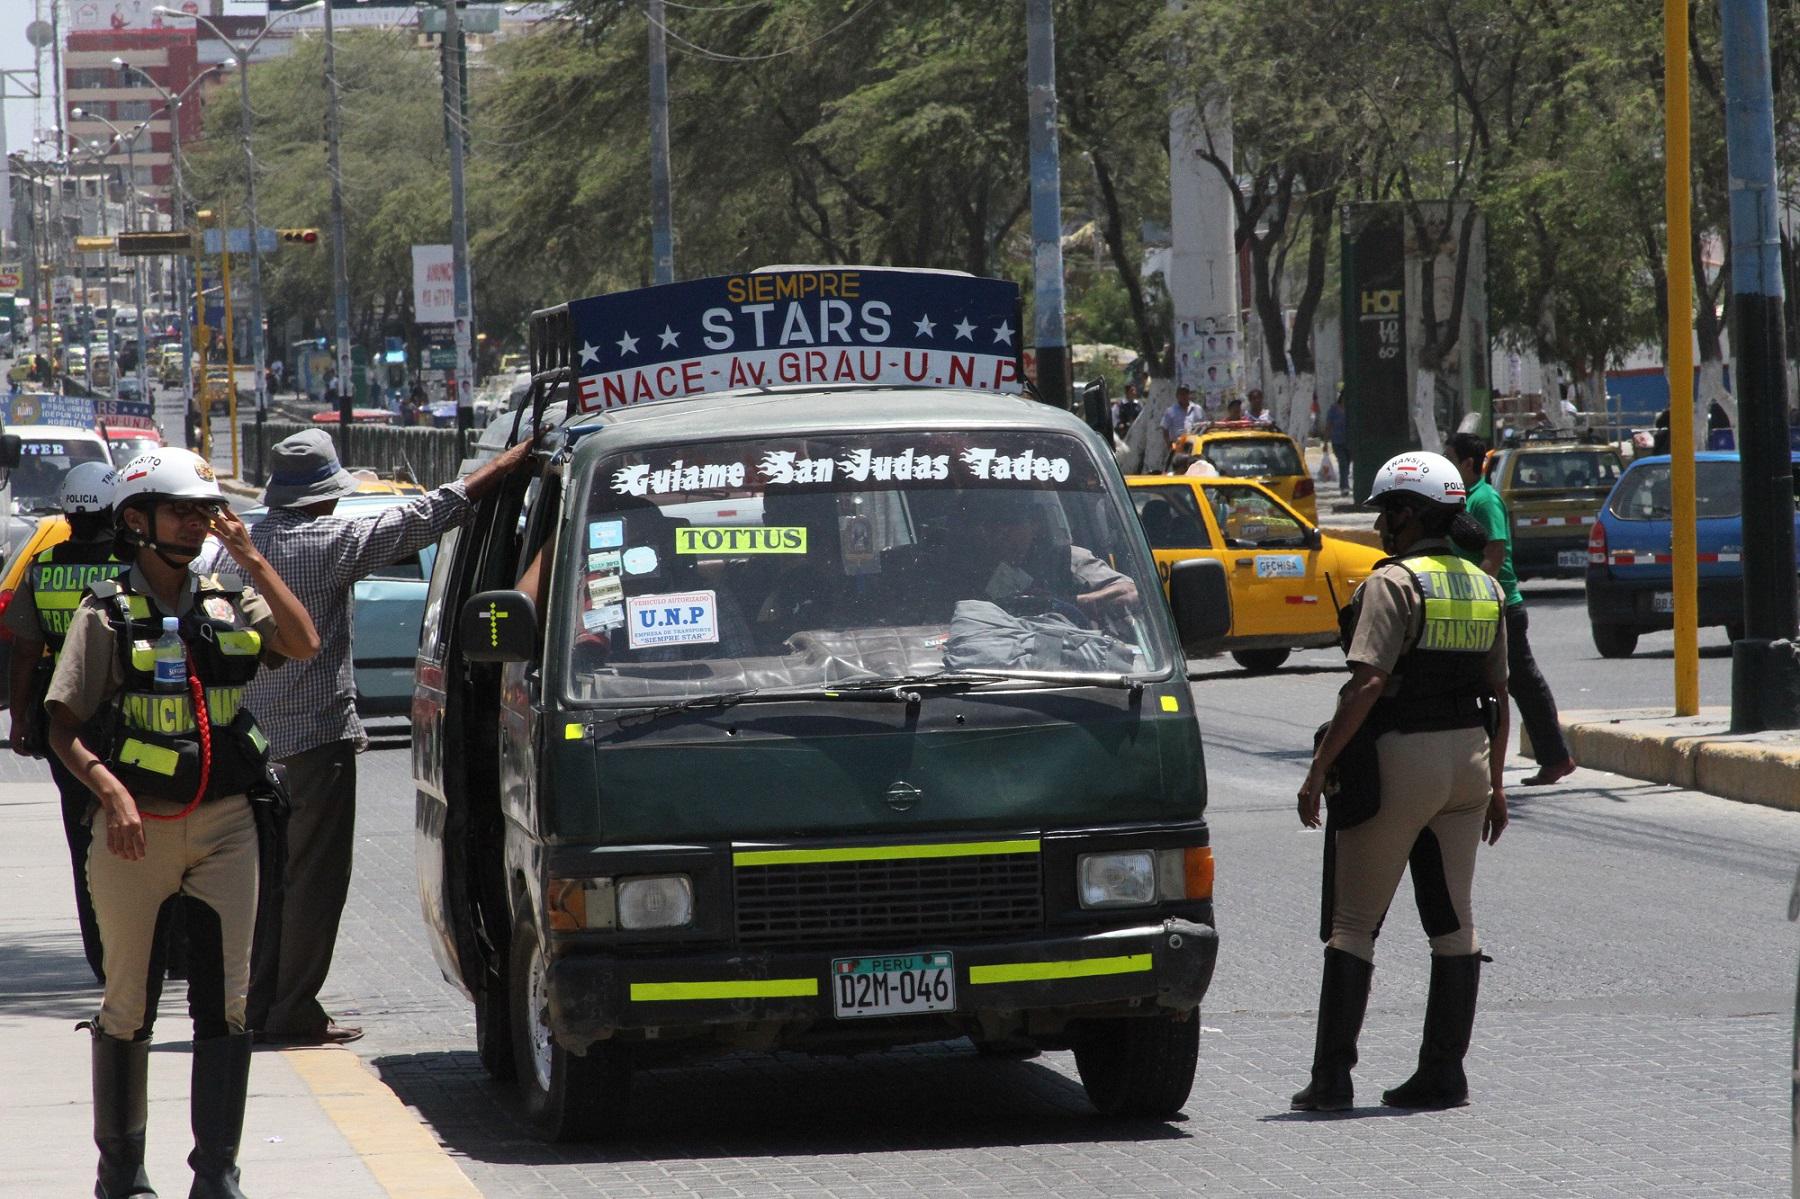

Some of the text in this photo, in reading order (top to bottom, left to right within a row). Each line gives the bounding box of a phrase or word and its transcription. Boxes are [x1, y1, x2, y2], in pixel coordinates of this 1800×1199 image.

[727, 272, 860, 303] SIEMPRE
[1362, 290, 1402, 313] HOT
[702, 300, 892, 350] STARS
[611, 447, 1071, 496] Guiame San Judas Tadeo
[1386, 457, 1430, 474] TRANSITO
[66, 494, 99, 504] POLICIA
[681, 529, 802, 550] TOTTUS
[1431, 572, 1491, 600] POLICIA
[639, 606, 704, 628] U.N.P
[1426, 620, 1497, 649] TRANSITO
[872, 959, 914, 972] PERU
[840, 968, 949, 1008] D2M-046
